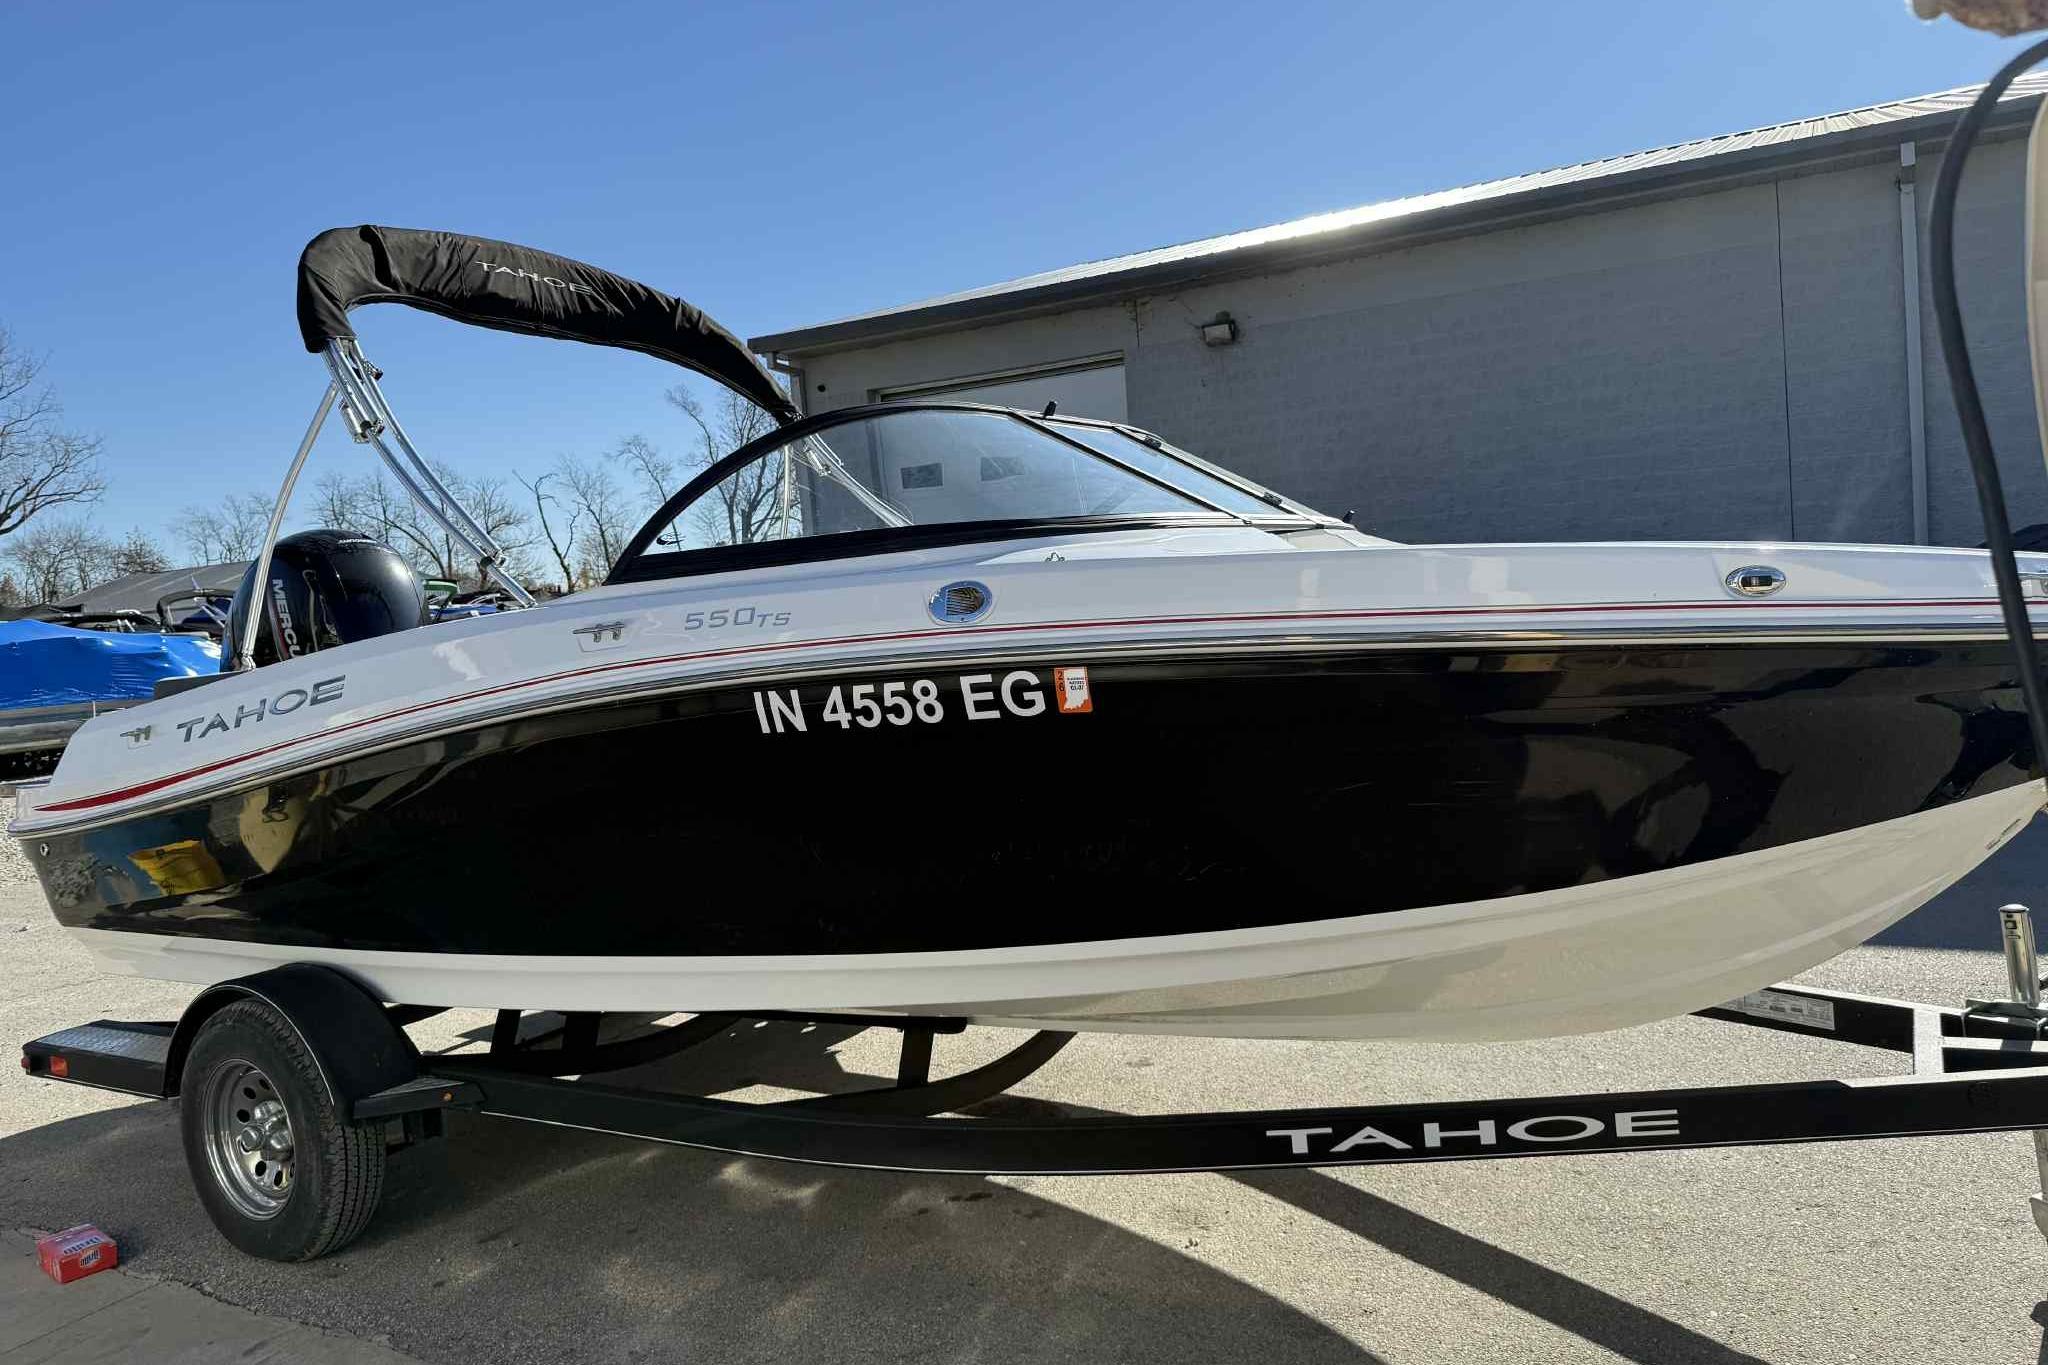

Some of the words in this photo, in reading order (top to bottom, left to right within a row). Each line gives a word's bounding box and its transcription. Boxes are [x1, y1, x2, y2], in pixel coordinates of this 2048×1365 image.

[475, 261, 593, 296] TAHOE
[176, 674, 346, 743] TAHOE
[753, 689, 808, 734] IN
[822, 679, 945, 729] 4558
[959, 670, 1046, 720] EG
[1266, 1109, 1680, 1154] TAHOE
